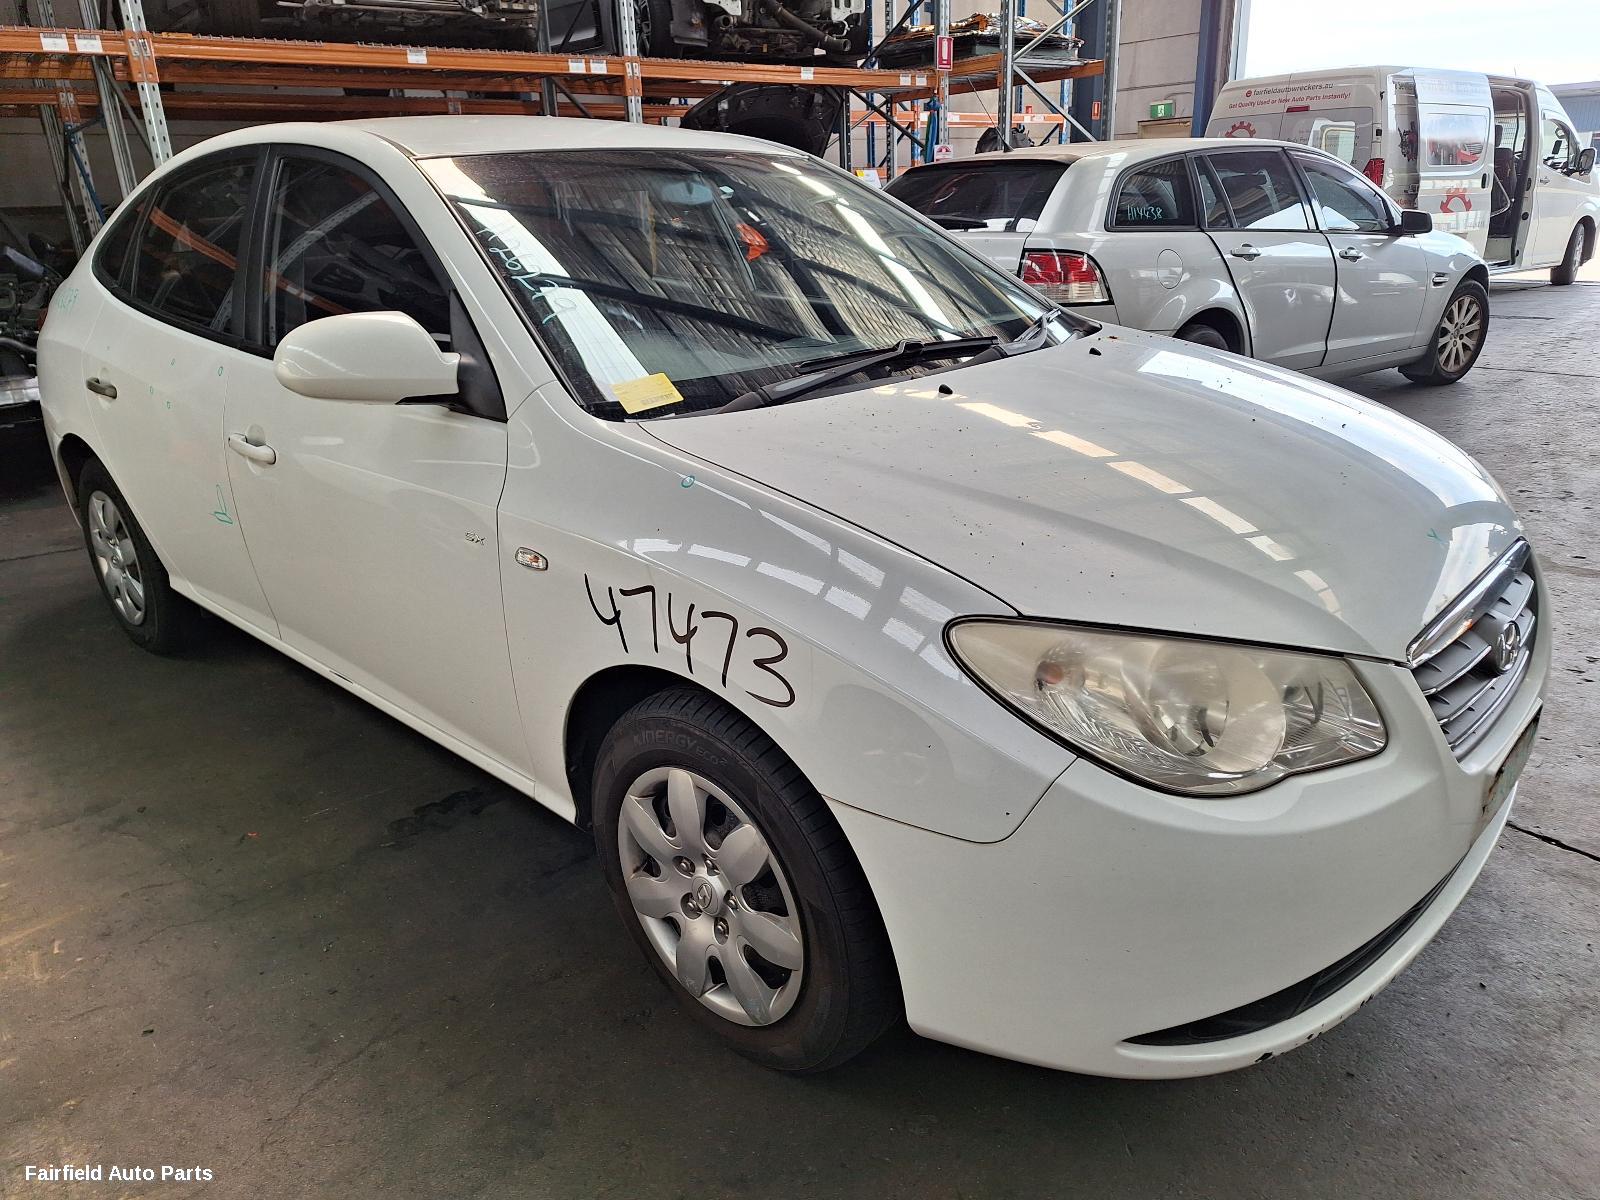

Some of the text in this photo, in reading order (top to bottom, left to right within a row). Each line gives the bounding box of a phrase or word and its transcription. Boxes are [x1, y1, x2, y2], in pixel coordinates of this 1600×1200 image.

[1253, 83, 1334, 96] fairfieldautowreckers.au
[1237, 101, 1256, 109] Quality
[1322, 92, 1351, 100] Instantly!
[584, 573, 796, 708] 47473
